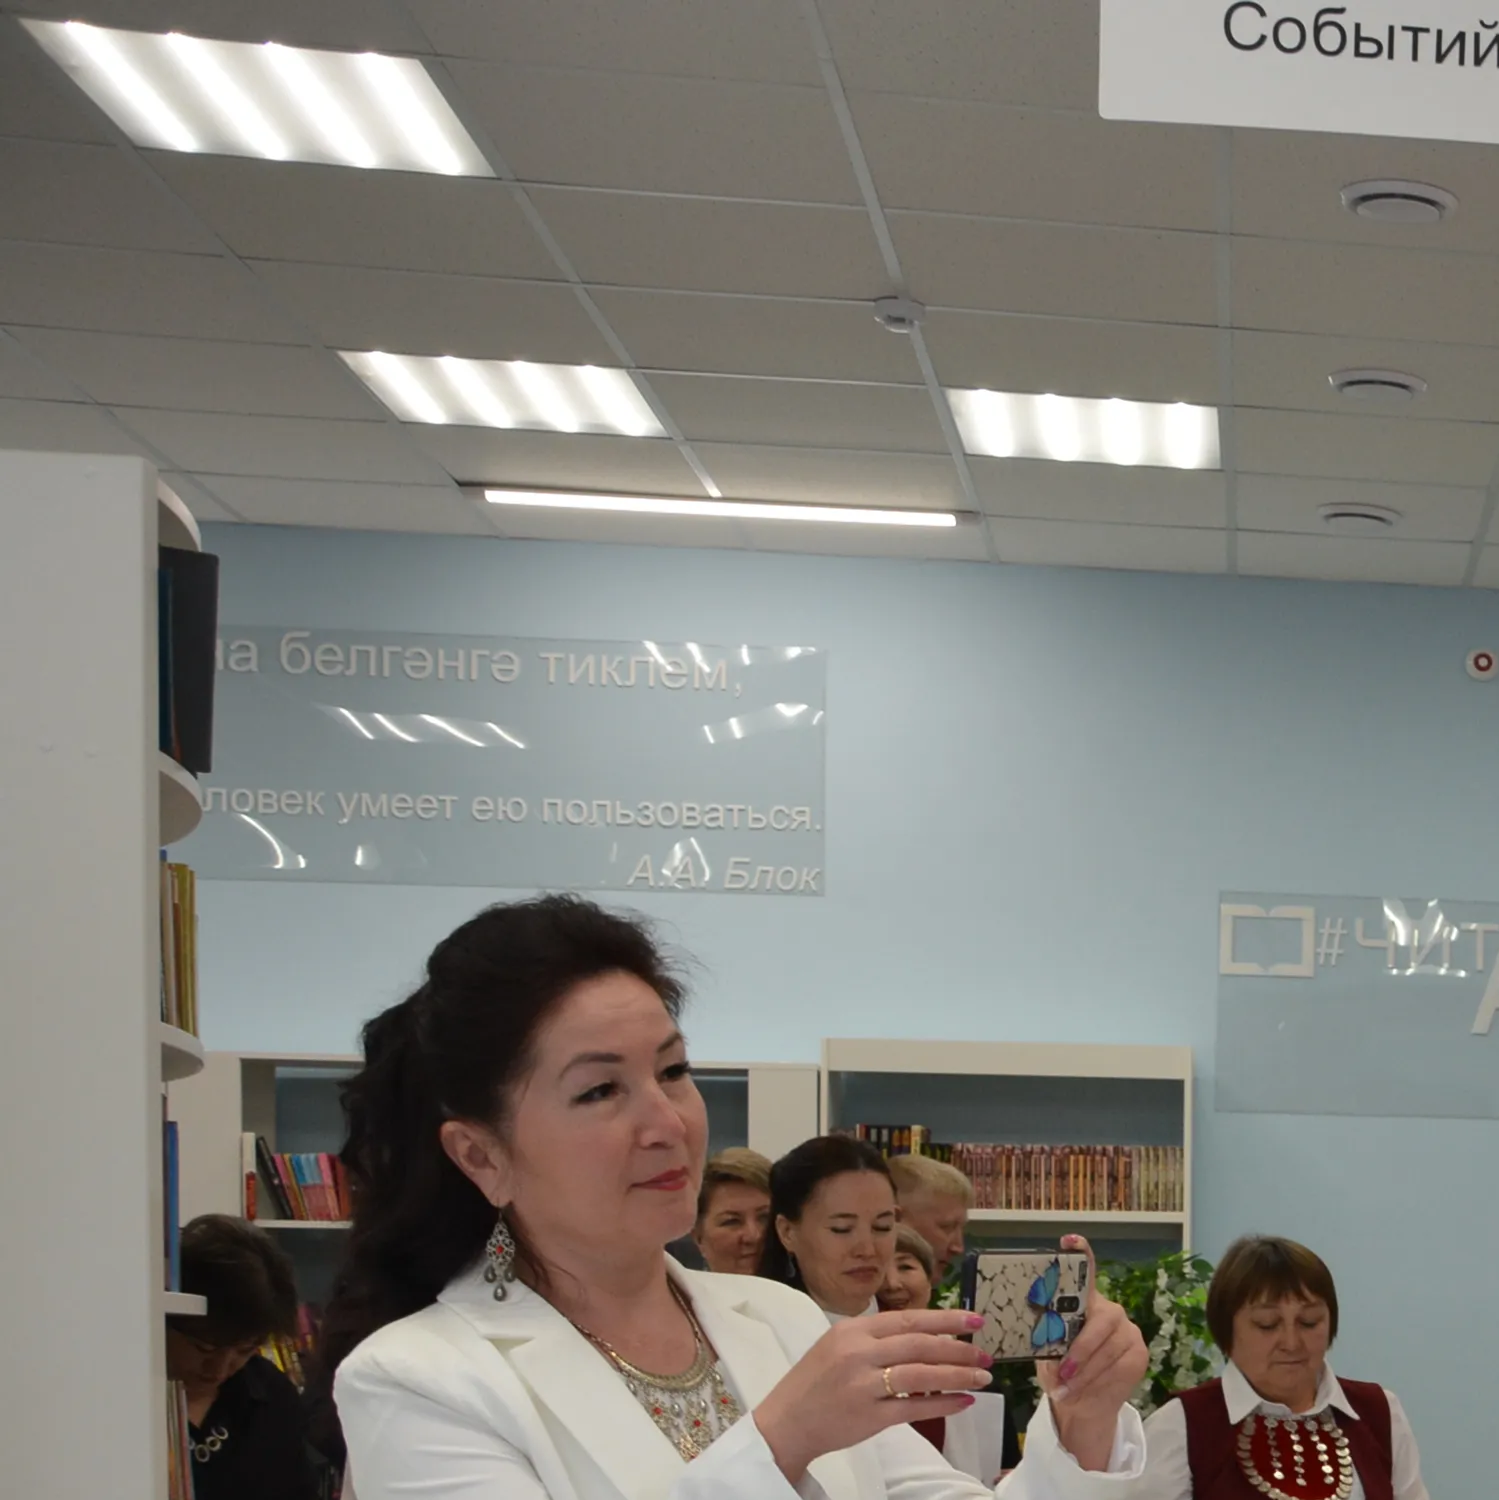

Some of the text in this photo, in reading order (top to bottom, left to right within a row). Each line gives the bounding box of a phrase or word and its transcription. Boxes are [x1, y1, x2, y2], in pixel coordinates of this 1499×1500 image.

[279, 630, 522, 684] белгәнгә
[539, 649, 744, 698] тиклем,
[201, 783, 823, 834] ловек умеет ею пользоваться.
[724, 854, 822, 893] Блок
